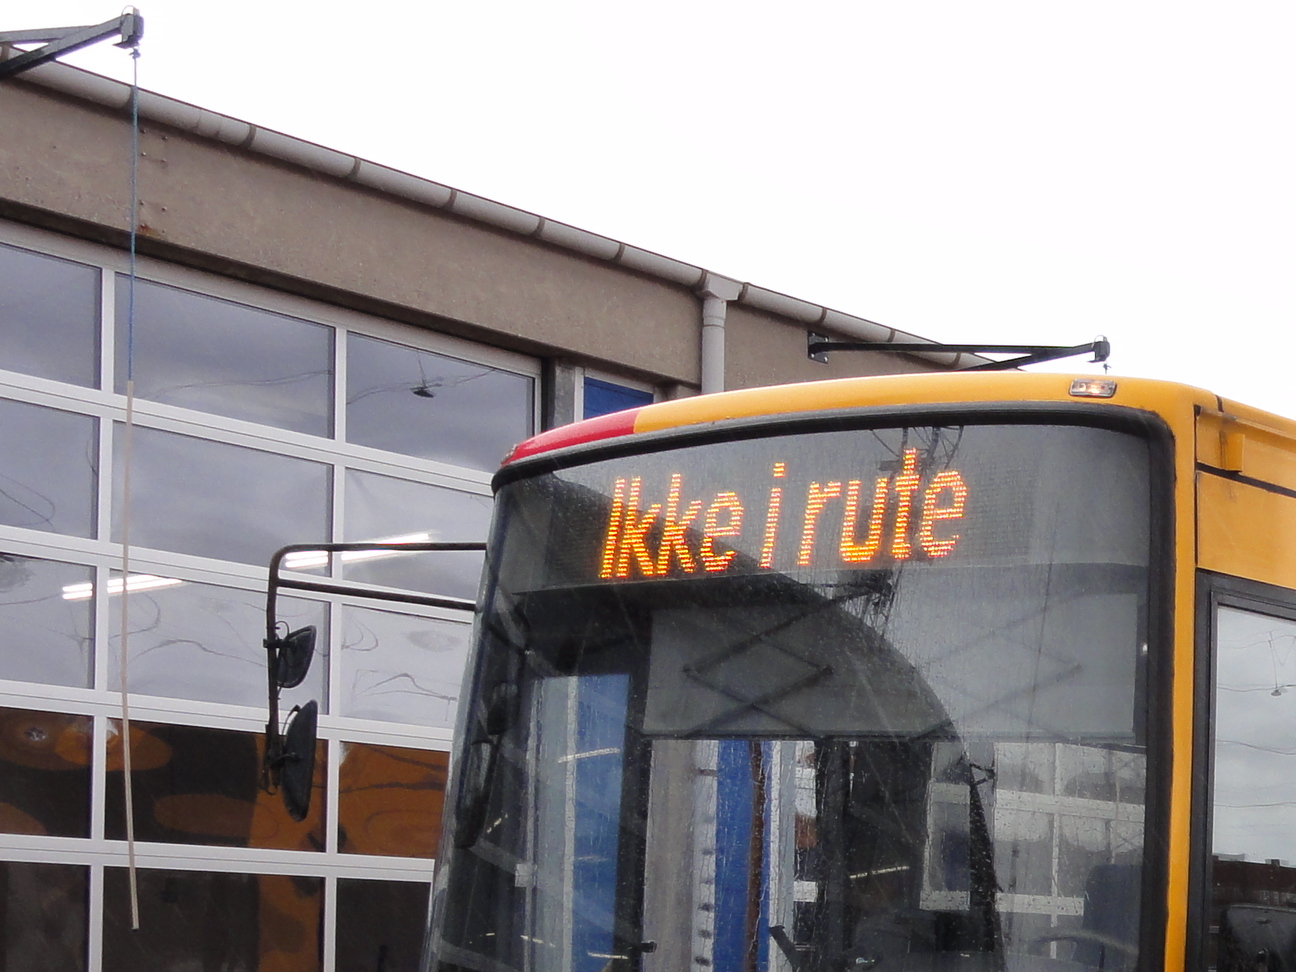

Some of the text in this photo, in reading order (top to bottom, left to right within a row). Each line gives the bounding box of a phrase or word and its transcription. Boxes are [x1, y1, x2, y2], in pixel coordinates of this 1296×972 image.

[599, 446, 968, 578] Ikke i rute
